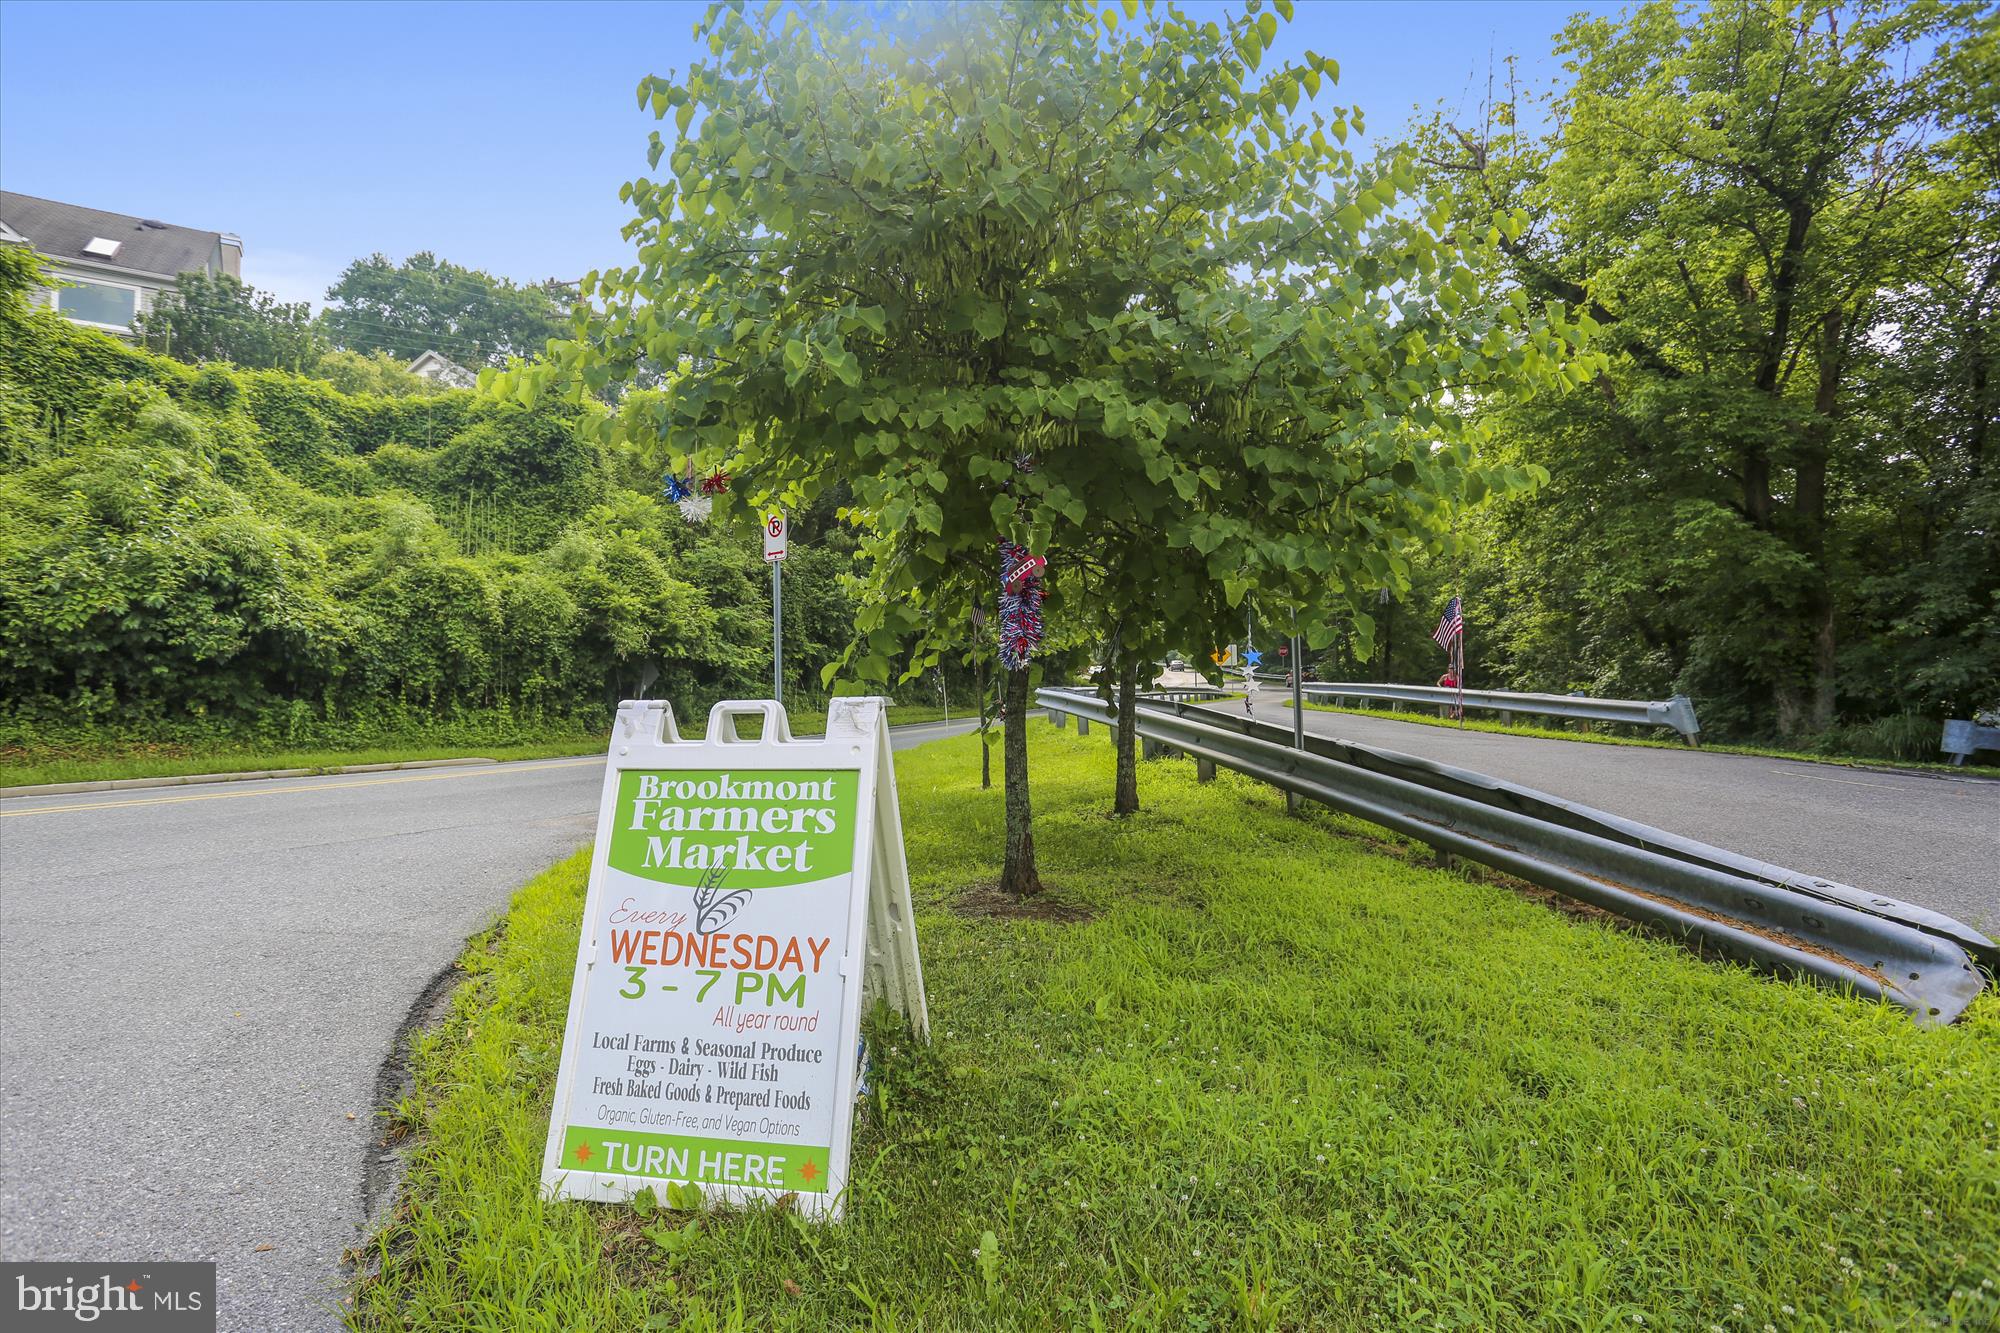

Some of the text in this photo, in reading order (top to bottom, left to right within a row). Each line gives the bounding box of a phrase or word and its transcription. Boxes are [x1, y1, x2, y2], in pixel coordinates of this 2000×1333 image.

[636, 774, 836, 801] Brookmont
[628, 799, 836, 834] Farmers
[641, 835, 814, 872] Market
[609, 897, 687, 933] Every
[611, 928, 830, 973] WEDNESDAY
[619, 966, 647, 999] 3
[695, 970, 722, 1003] 7
[734, 972, 806, 1008] PM
[713, 1006, 819, 1033] All year round
[592, 1032, 823, 1064] Local Farms & Seasonal Produce
[627, 1055, 656, 1078] Eggs
[668, 1058, 704, 1082] Dairy
[717, 1060, 747, 1080] Wild
[751, 1063, 778, 1082] Fish
[592, 1076, 811, 1111] Fresh Baked Goods & Prepared Foods
[597, 1104, 800, 1137] Organic, Gluten-Free, and Vegan Options
[601, 1141, 786, 1185] TURN HERE
